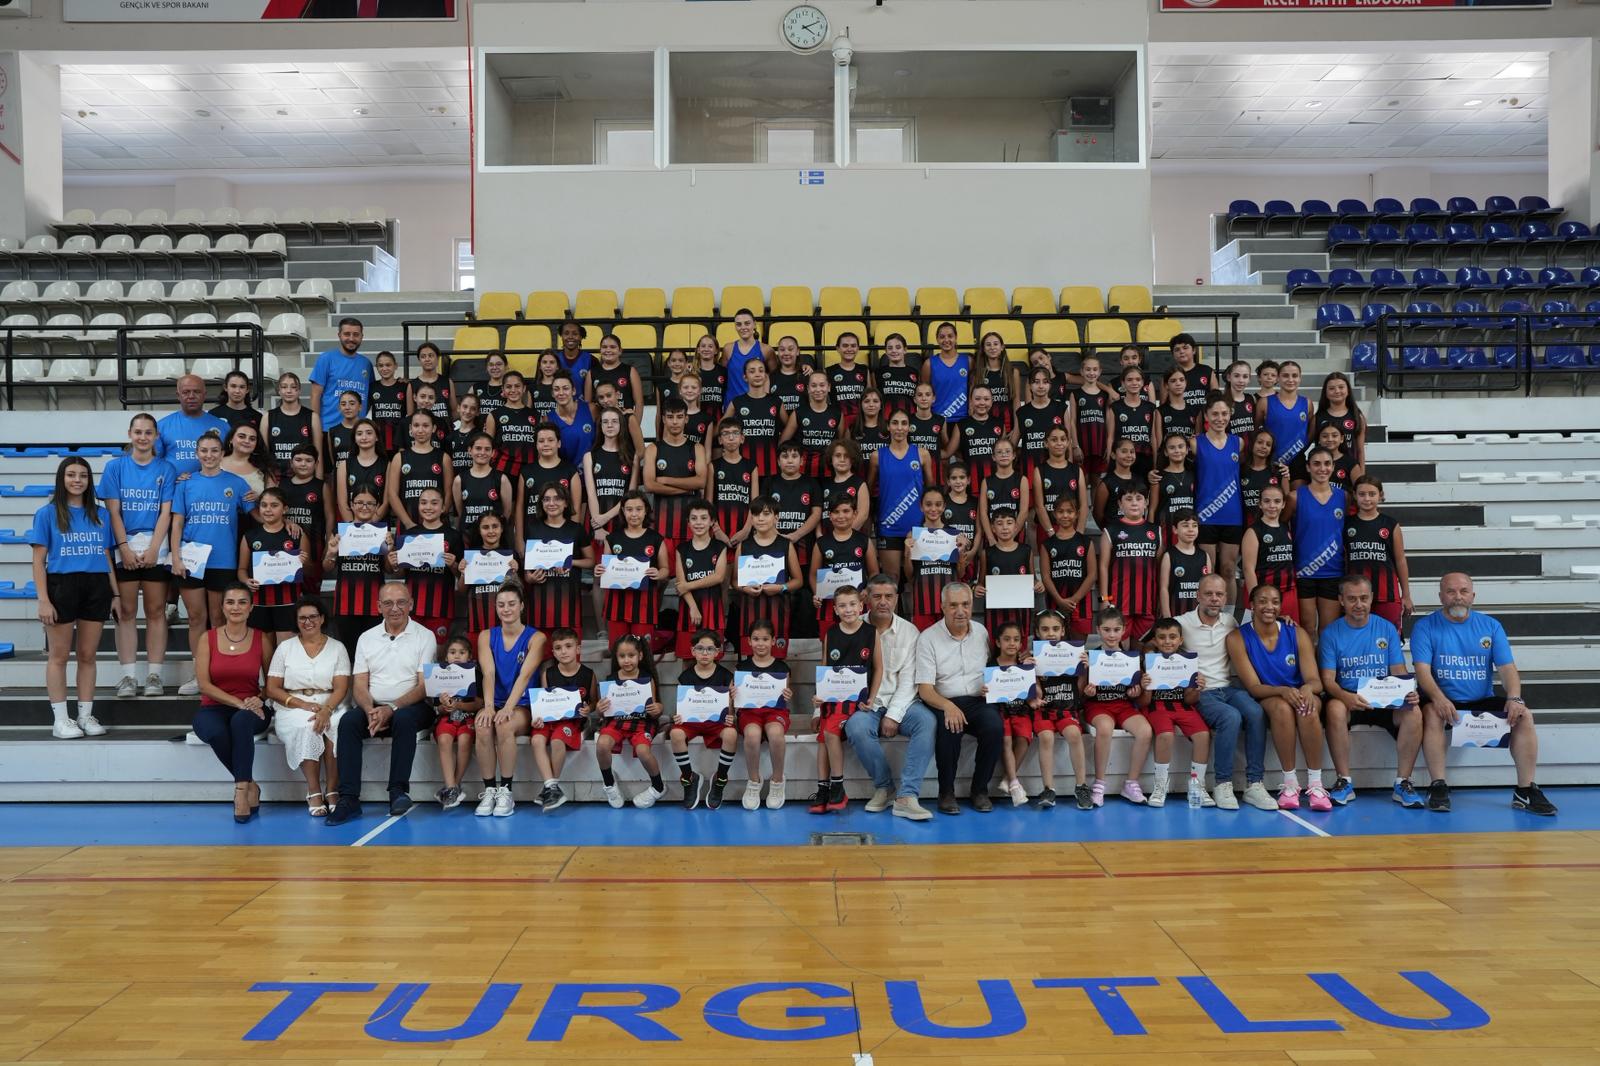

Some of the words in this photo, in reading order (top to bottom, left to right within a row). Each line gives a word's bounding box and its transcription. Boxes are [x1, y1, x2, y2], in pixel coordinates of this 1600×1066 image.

[702, 386, 722, 394] RGUTLU
[943, 393, 967, 418] GUTLU
[375, 410, 401, 418] BELEDİYES
[501, 434, 535, 442] BELEDİYES
[1027, 432, 1045, 440] TURG
[176, 440, 198, 449] TURG
[122, 500, 160, 511] ELEDİYESİ
[188, 513, 230, 525] BELEDİYES
[776, 520, 804, 529] ELEDİYE
[1350, 542, 1386, 551] TURGUTLU
[1116, 548, 1156, 557] BELEDİYES
[341, 561, 380, 572] BELEDİYES
[688, 570, 714, 580] TURG
[475, 583, 500, 594] BELEDİY
[1342, 653, 1385, 668] TURGUTLU
[1439, 655, 1486, 667] TURGUTLU
[1437, 667, 1487, 680] BELEDİYES
[243, 971, 1490, 1042] TURGUTLU
